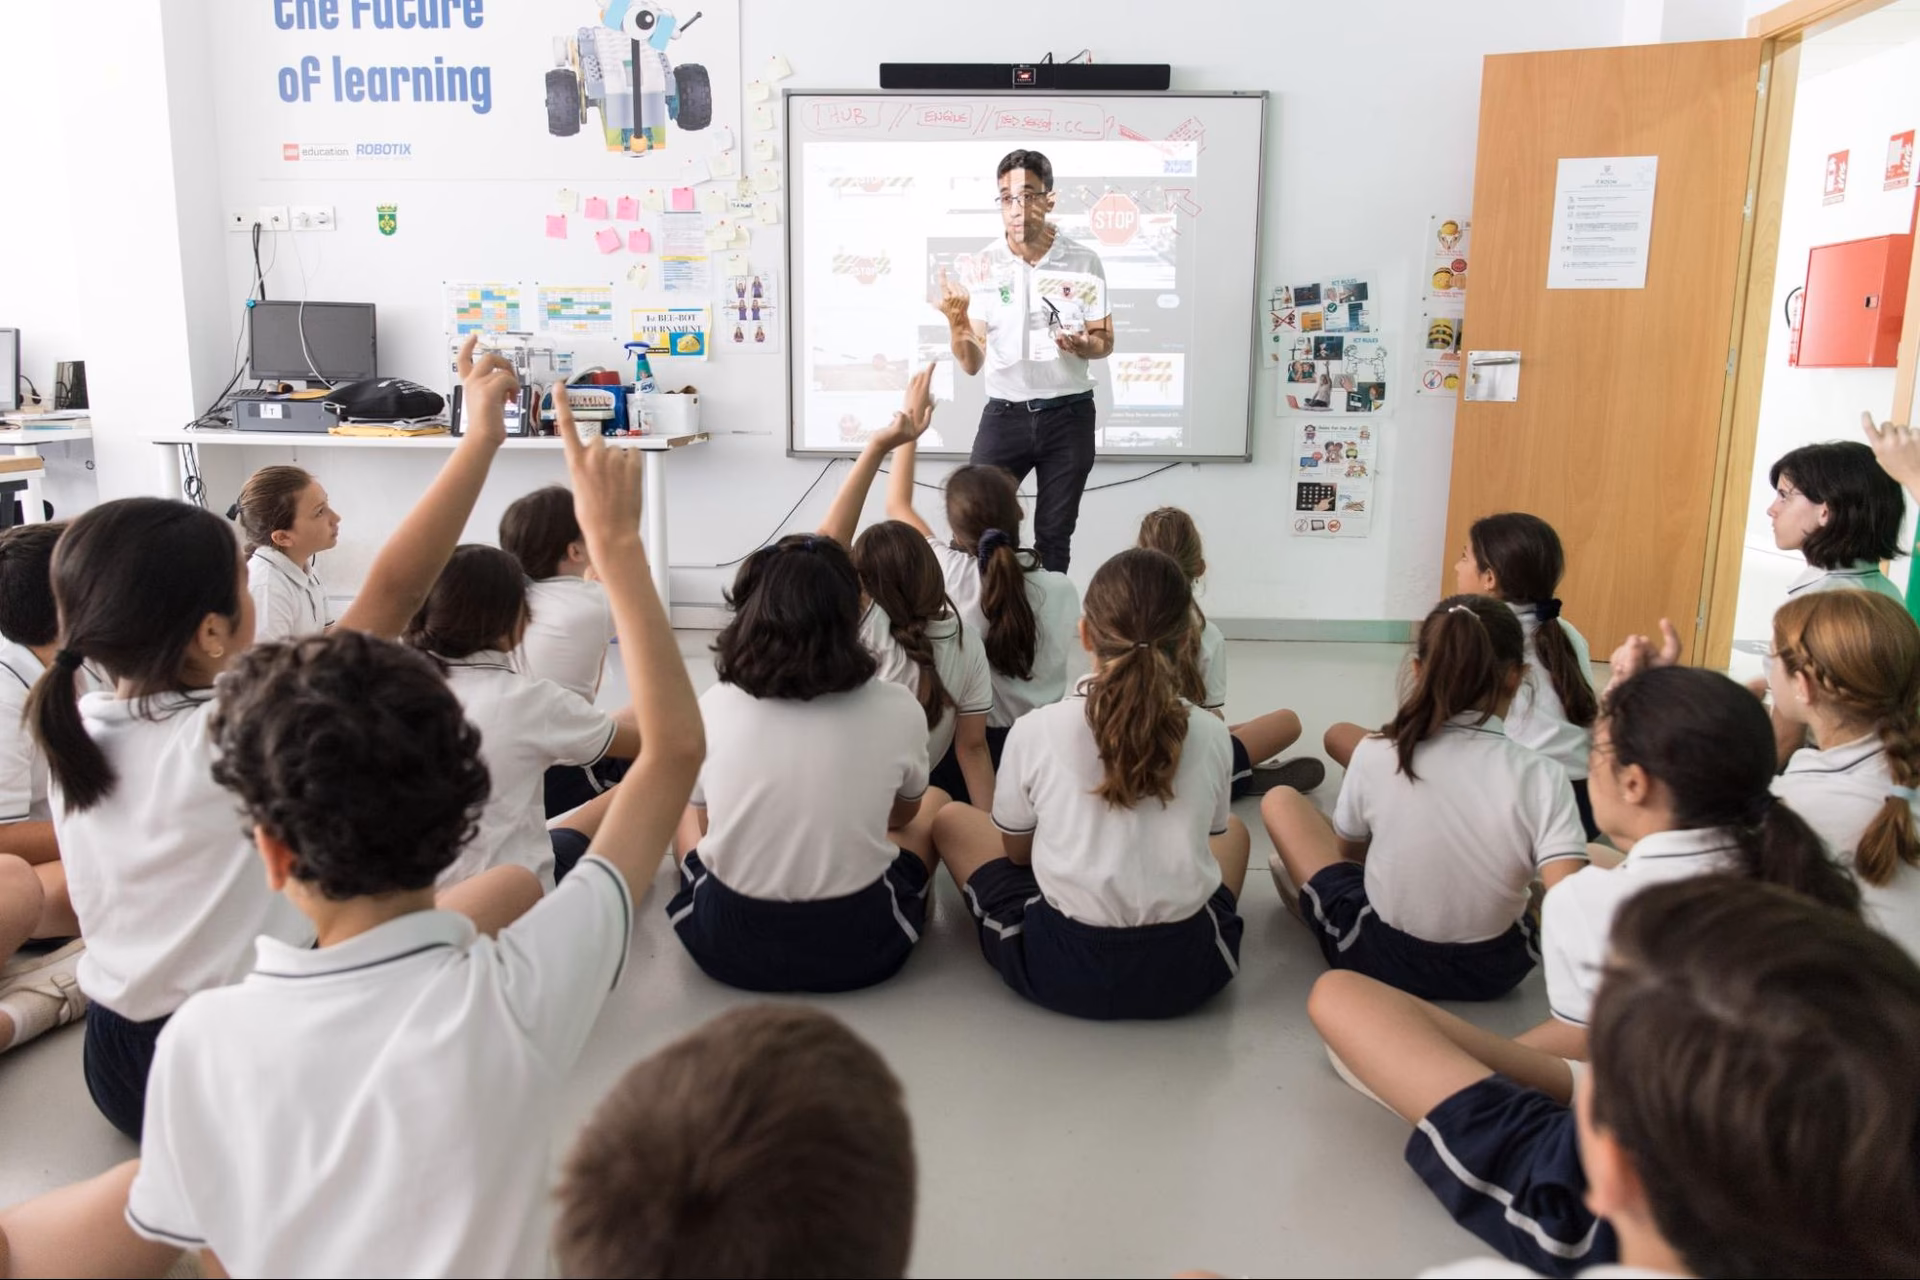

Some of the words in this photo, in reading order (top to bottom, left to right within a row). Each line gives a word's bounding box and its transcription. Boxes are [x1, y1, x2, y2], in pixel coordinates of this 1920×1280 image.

[274, 0, 340, 30] the
[352, 0, 484, 30] Future
[278, 55, 321, 102] of
[332, 55, 492, 115] learning
[302, 147, 349, 157] education
[356, 143, 412, 155] ROBOTIX
[1095, 210, 1135, 230] STOP
[658, 314, 696, 322] BEE-BOT
[642, 325, 702, 333] TOURNAMENT
